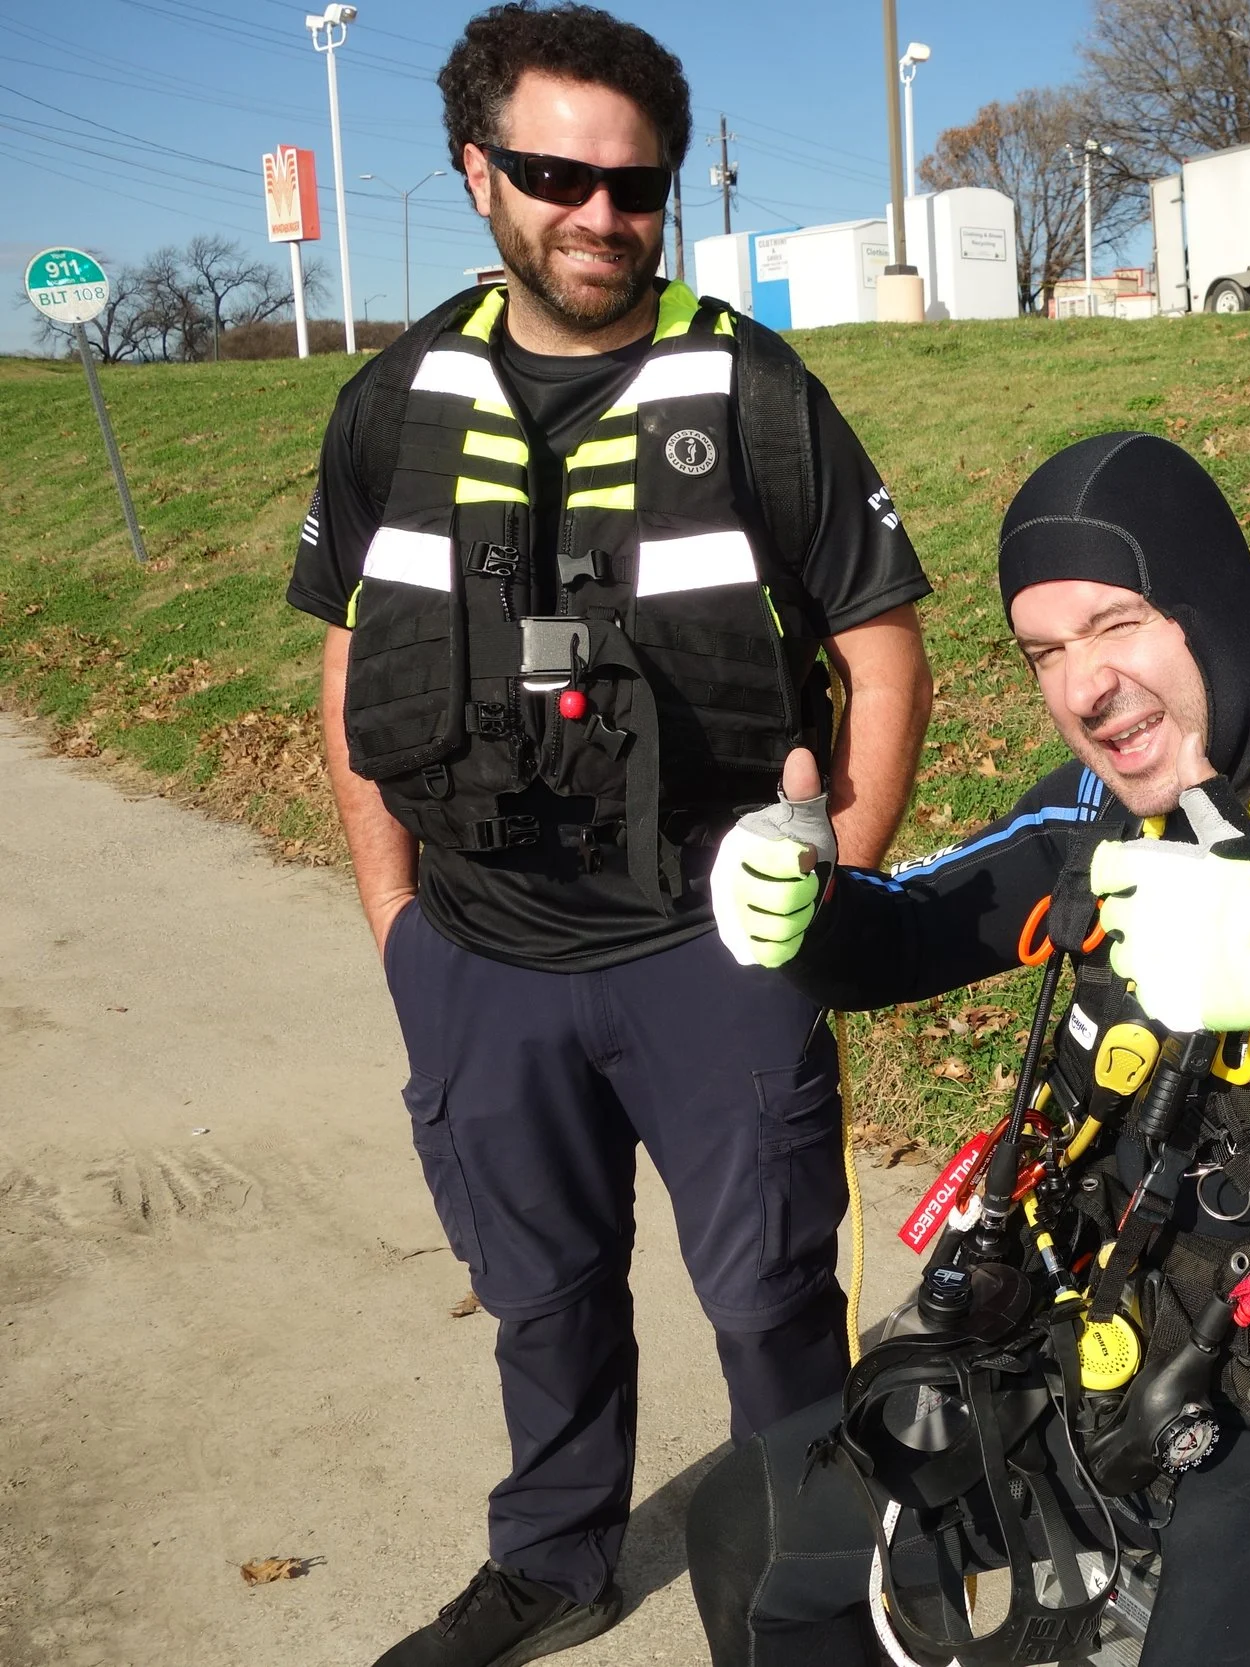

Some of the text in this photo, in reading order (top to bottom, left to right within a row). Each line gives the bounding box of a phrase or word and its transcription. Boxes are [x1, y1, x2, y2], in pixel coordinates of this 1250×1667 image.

[758, 239, 787, 248] CLOTHIN
[866, 248, 889, 256] Clothin
[45, 259, 81, 278] 911
[39, 287, 105, 306] BLT 108
[668, 431, 713, 451] MUSTANG
[668, 452, 713, 473] SURVIVAL
[908, 1149, 979, 1245] PULL TO EJECT
[1093, 1331, 1109, 1357] mares
